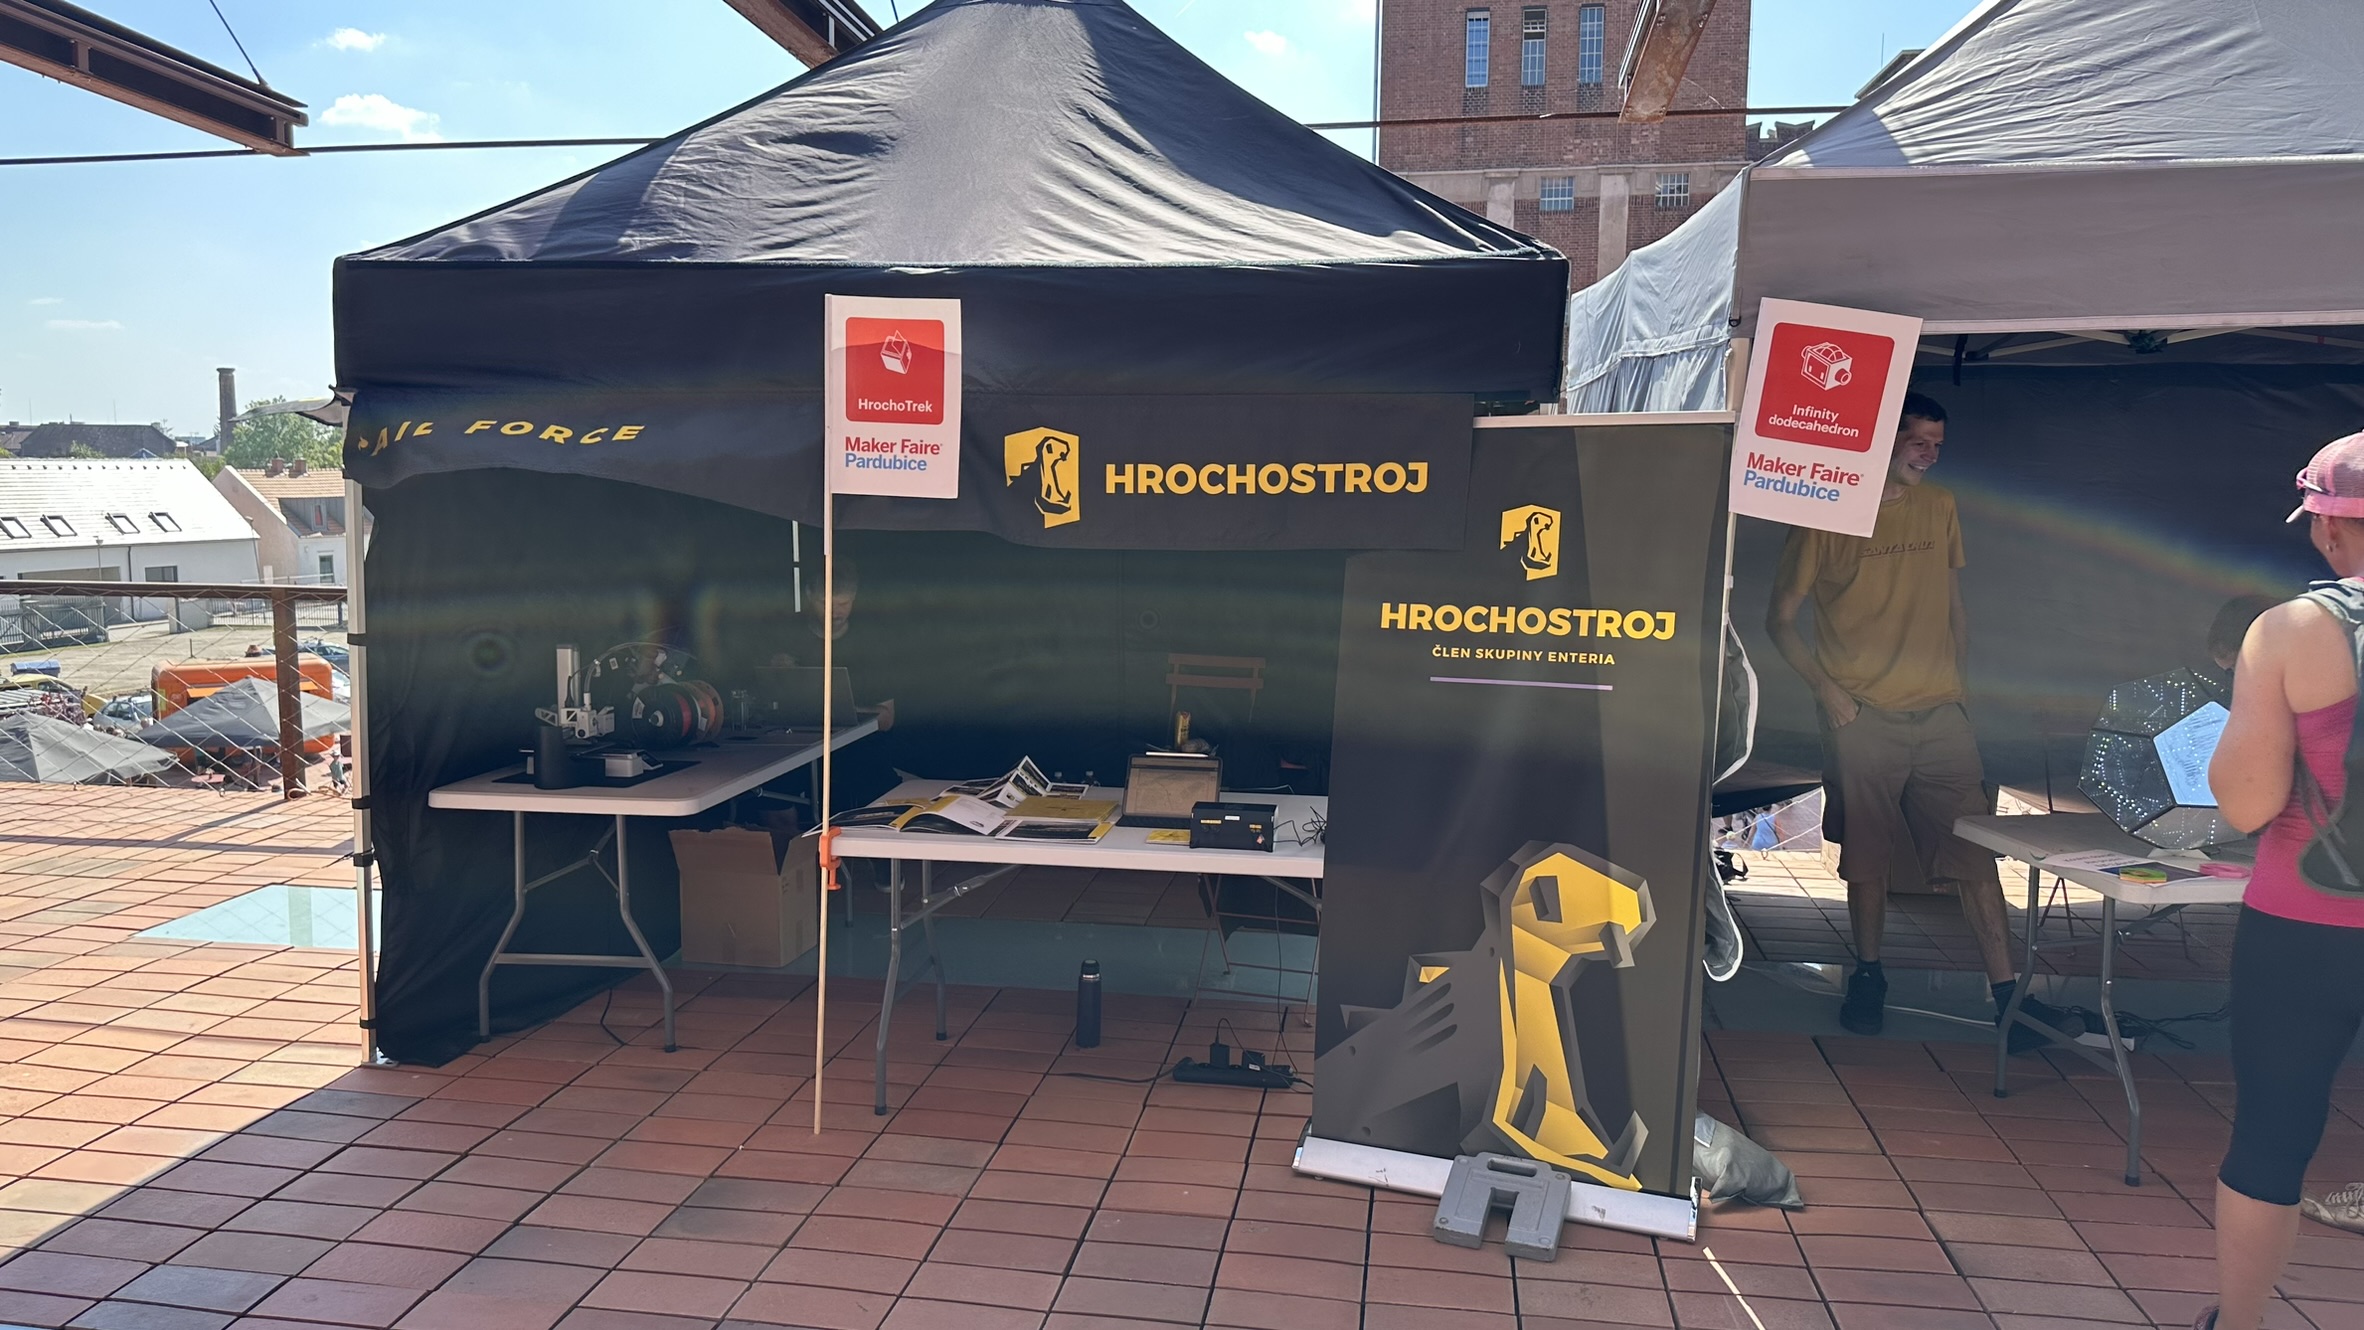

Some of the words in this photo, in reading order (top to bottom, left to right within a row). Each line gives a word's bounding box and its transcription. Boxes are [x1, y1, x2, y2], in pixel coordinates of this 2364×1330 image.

[858, 398, 933, 413] HrochoTrek
[1792, 404, 1839, 423] Infinity
[464, 420, 645, 445] FORCE
[1768, 414, 1859, 438] dodecahedron
[845, 436, 897, 453] Maker
[901, 438, 941, 455] Faire
[845, 453, 927, 471] Pardubice
[1747, 452, 1806, 477] Maker
[1810, 462, 1861, 486] Faire
[1105, 461, 1429, 494] HROCHOSTROJ
[1743, 469, 1840, 502] Pardubice
[1380, 602, 1676, 640] HROCHOSTROJ
[1432, 644, 1470, 659] ČLEN
[1475, 647, 1543, 662] SKUPINY
[1548, 651, 1616, 666] ENTERIA
